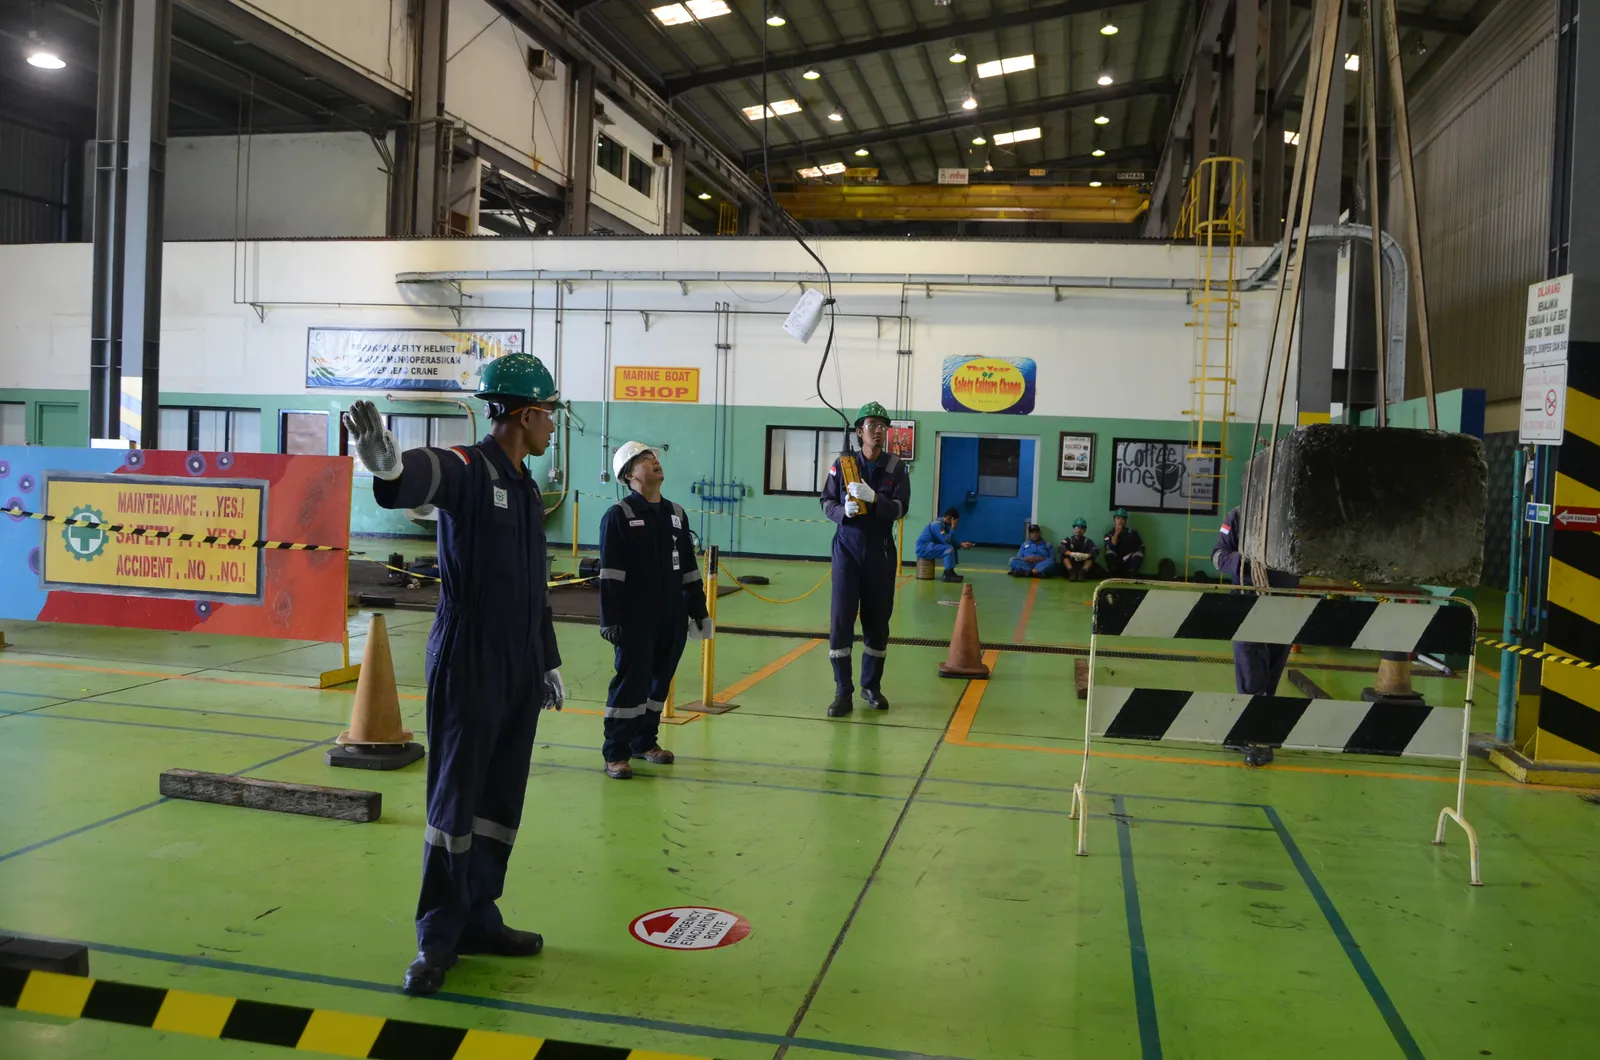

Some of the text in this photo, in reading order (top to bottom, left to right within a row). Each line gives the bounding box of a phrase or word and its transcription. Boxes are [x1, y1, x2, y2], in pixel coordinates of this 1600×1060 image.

[424, 345, 456, 353] HELMET
[410, 367, 438, 375] CRANE
[623, 370, 690, 382] MARINE BOAT
[624, 385, 689, 398] SHOP
[954, 376, 1021, 397] Safety Culture Change
[1122, 442, 1177, 468] Coffee
[1117, 462, 1156, 488] ime
[117, 491, 197, 517] MAINTENANCE
[115, 554, 174, 579] ACCIDENT
[664, 910, 703, 944] EMERGENCY
[680, 911, 719, 946] EVACUATION
[703, 921, 728, 940] ROUTE
